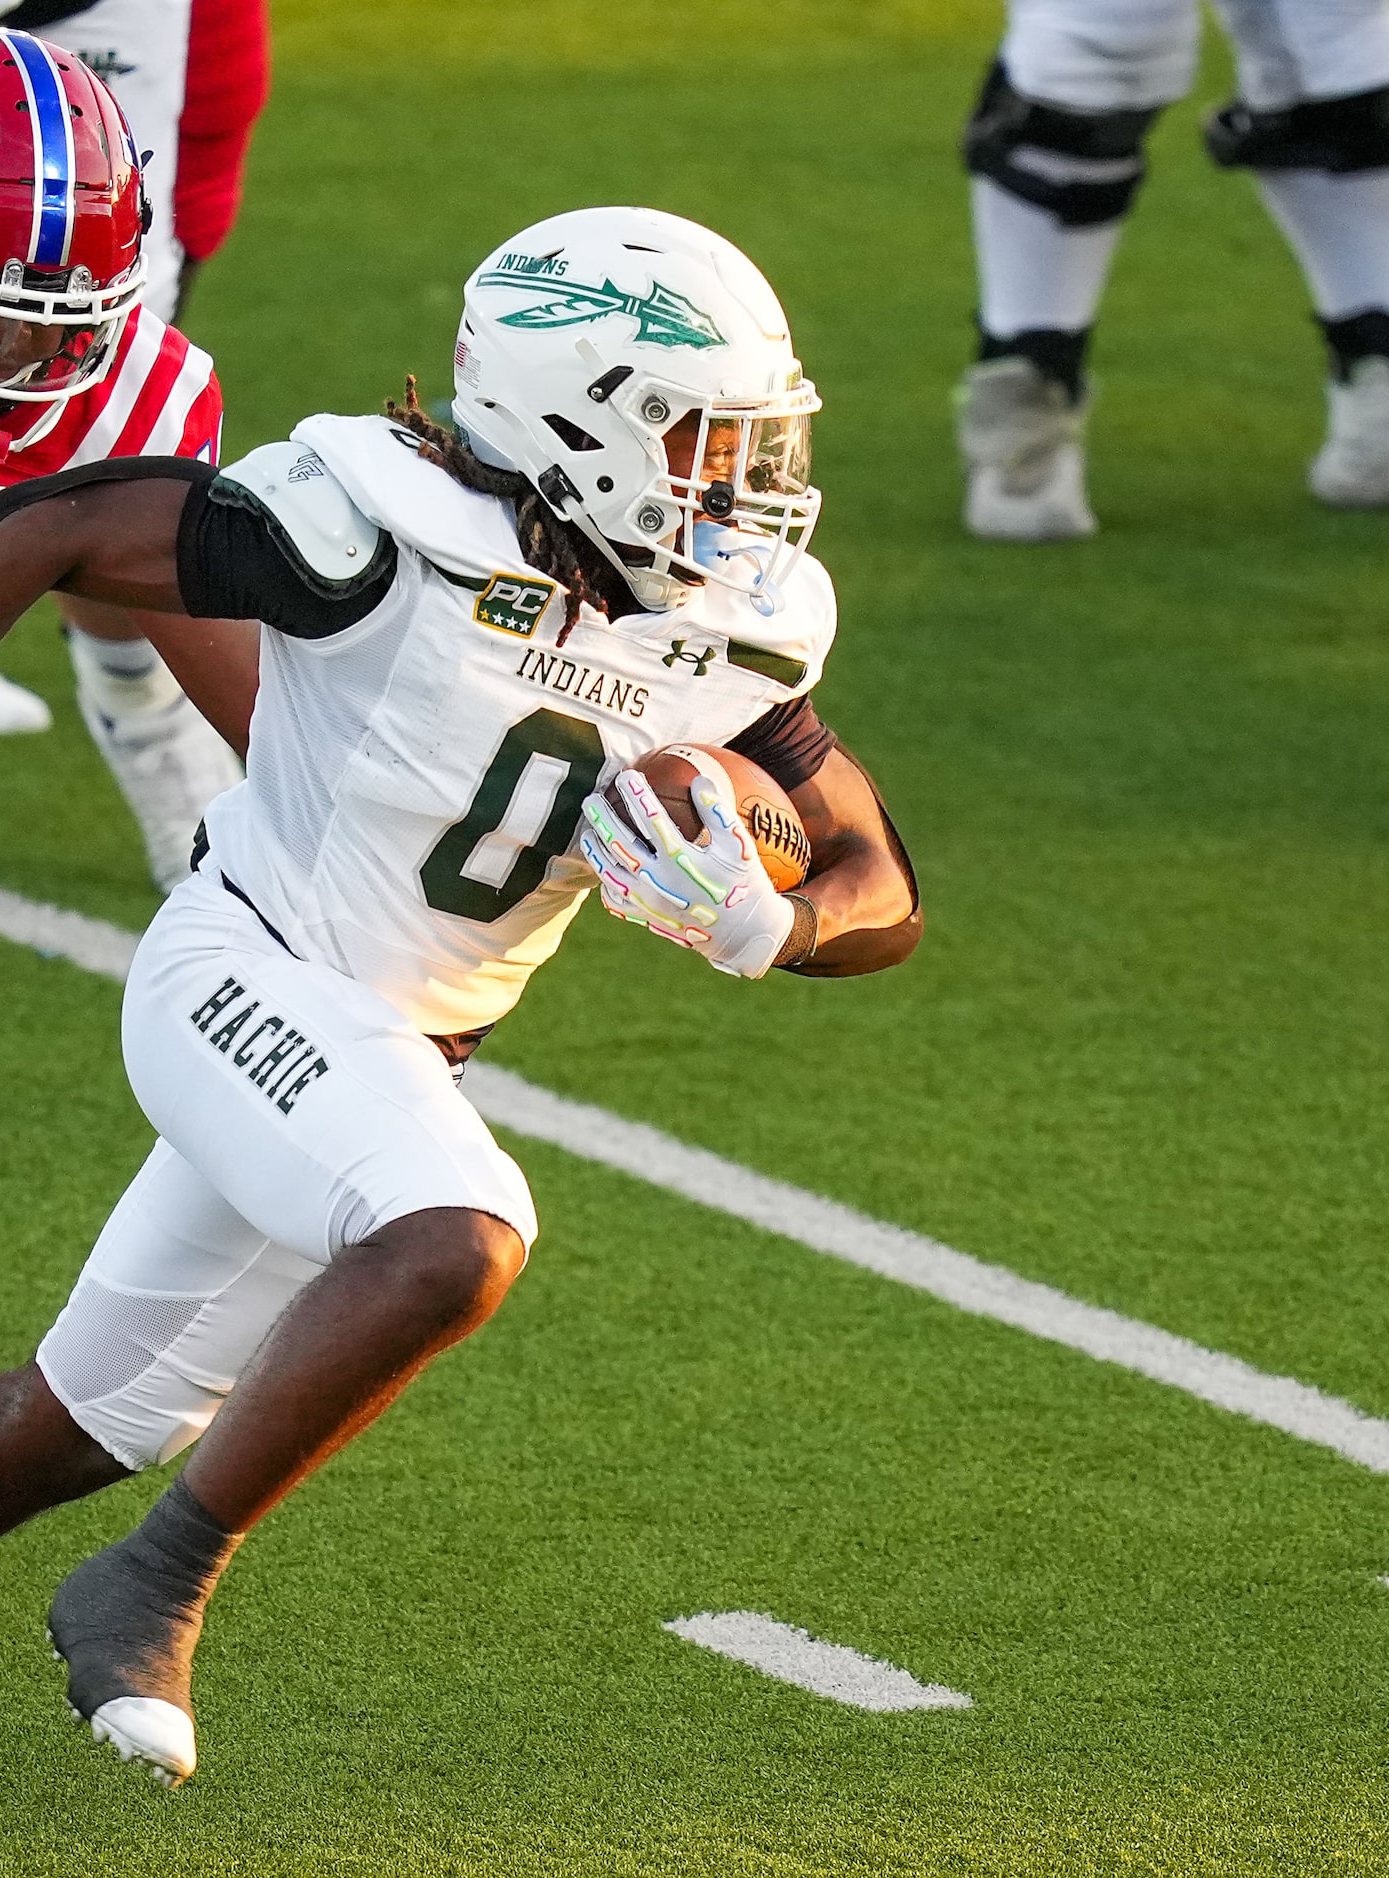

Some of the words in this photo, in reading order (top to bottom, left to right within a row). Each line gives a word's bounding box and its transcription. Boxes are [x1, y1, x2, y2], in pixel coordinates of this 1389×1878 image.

[484, 581, 549, 615] PC
[516, 647, 650, 718] INDIANS
[415, 705, 608, 926] 0
[189, 975, 330, 1117] HACHIE
